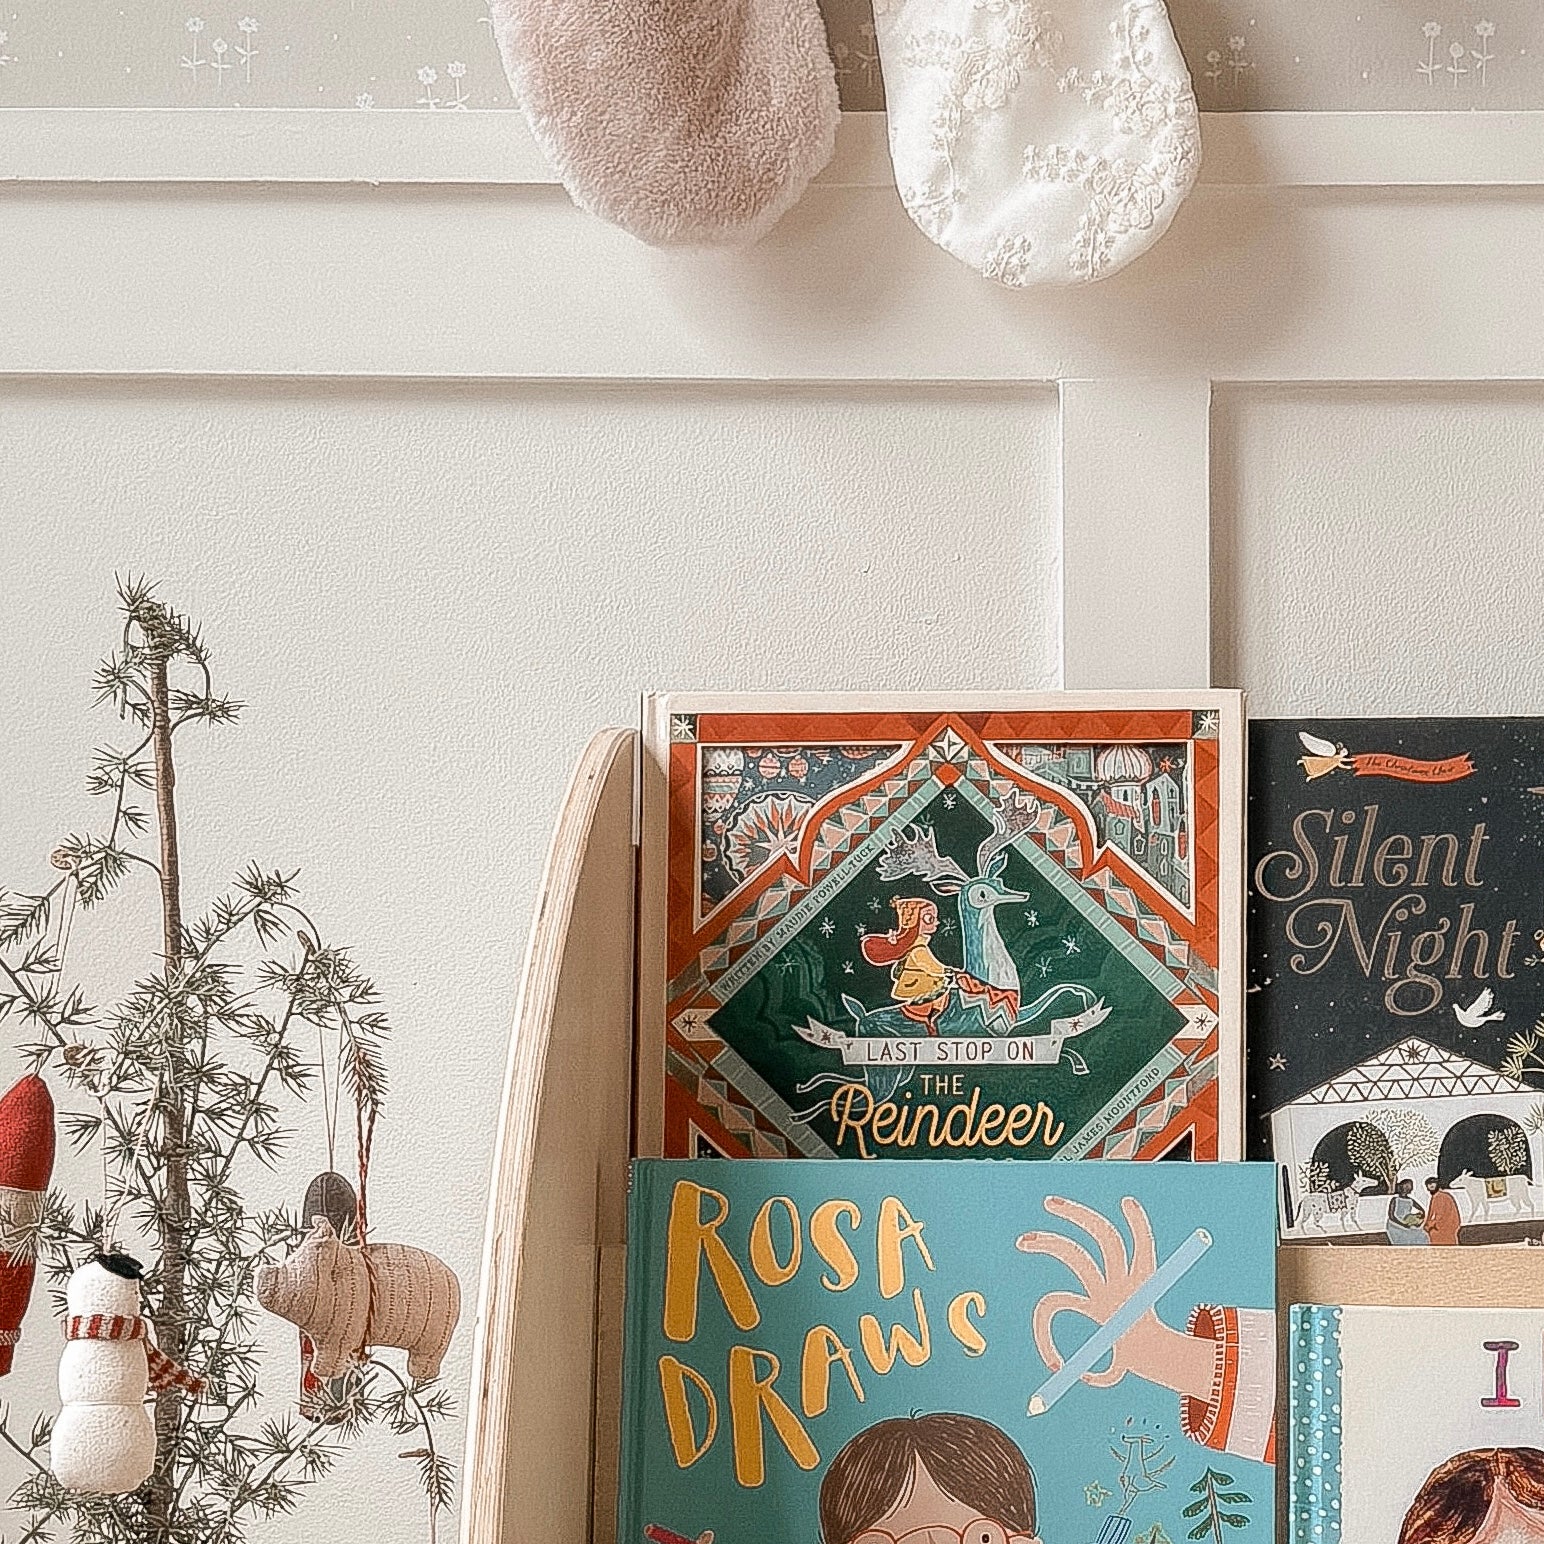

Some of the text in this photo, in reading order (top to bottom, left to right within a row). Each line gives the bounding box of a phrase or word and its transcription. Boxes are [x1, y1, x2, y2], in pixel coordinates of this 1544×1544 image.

[1255, 804, 1492, 902] Silent
[1285, 894, 1520, 1016] Night
[867, 1041, 1034, 1061] LAST STOP ON
[920, 1074, 965, 1095] THE
[831, 1083, 1064, 1159] Reindeer
[662, 1180, 935, 1342] ROSA
[658, 1287, 988, 1489] DRAWS
[1481, 1340, 1520, 1408] I
